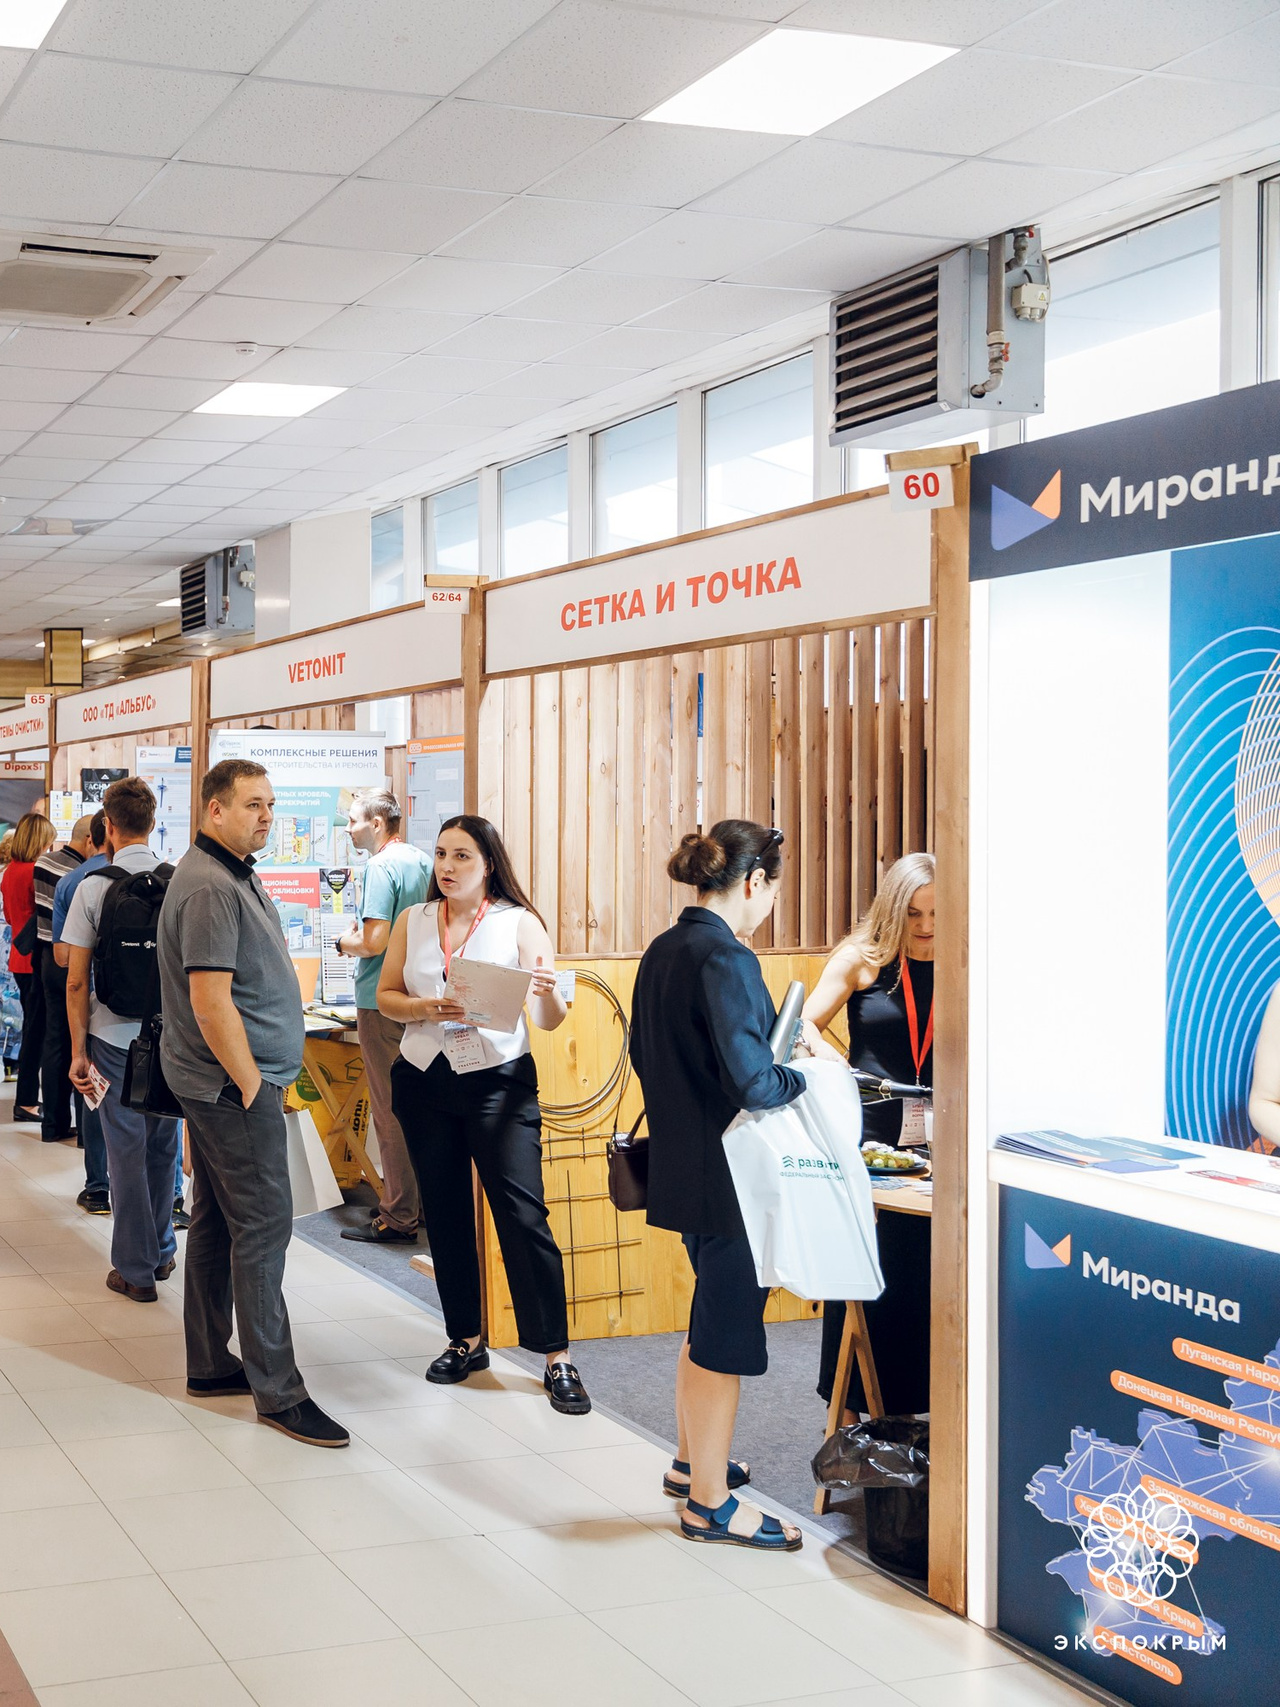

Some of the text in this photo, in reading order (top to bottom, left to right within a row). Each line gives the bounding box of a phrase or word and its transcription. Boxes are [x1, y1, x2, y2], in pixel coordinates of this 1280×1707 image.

[904, 472, 940, 501] 60
[432, 591, 462, 603] 62/64
[561, 556, 802, 632] СЕТКА И ТОЧКА
[287, 652, 346, 684] VETONIT
[30, 695, 45, 704] 65
[83, 706, 99, 722] ООО
[4, 762, 42, 772] DipoxSi
[250, 748, 326, 757] КОМПЛЕКСНЫЕ
[330, 749, 378, 758] РЕШЕНИЯ
[268, 761, 333, 769] СТРОИТЕЛЬСТВА
[272, 887, 314, 895] ОБЛИЦОВКИ
[1082, 1250, 1240, 1324] Миранда
[1180, 1342, 1280, 1386] Луганская Наро
[1117, 1375, 1173, 1404] Донецкая
[1175, 1396, 1235, 1426] Народная
[1147, 1480, 1226, 1522] Запорожская
[1162, 1601, 1196, 1631] Крым
